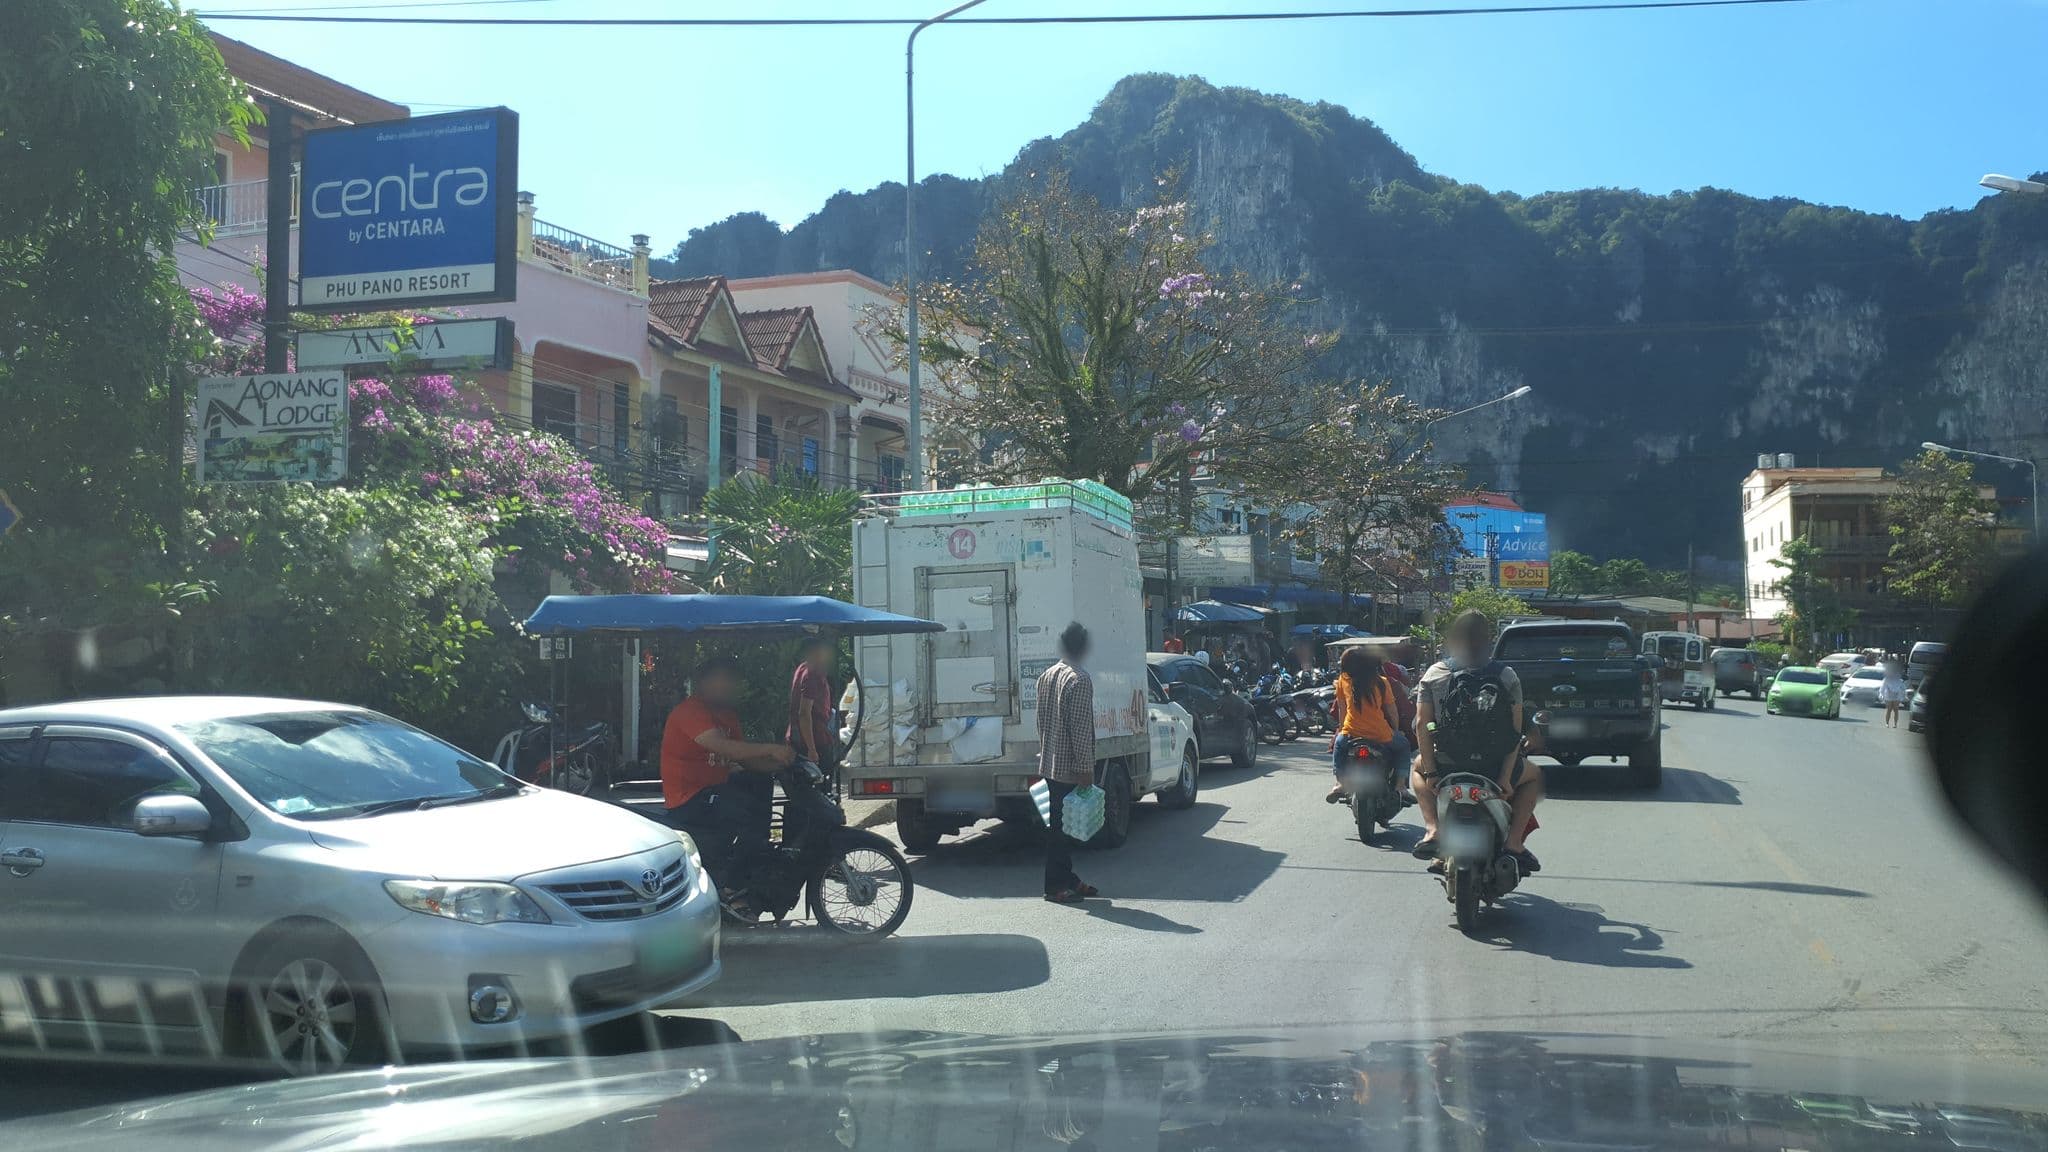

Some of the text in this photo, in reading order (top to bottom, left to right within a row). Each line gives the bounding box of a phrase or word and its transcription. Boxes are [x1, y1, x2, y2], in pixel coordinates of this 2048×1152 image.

[312, 163, 488, 219] centra
[349, 217, 446, 243] by CENTARA
[326, 272, 471, 298] PHU PANO RESORT
[235, 377, 339, 411] AONANG
[262, 402, 338, 427] LODGE
[953, 535, 973, 553] 14
[1501, 538, 1546, 552] Advice
